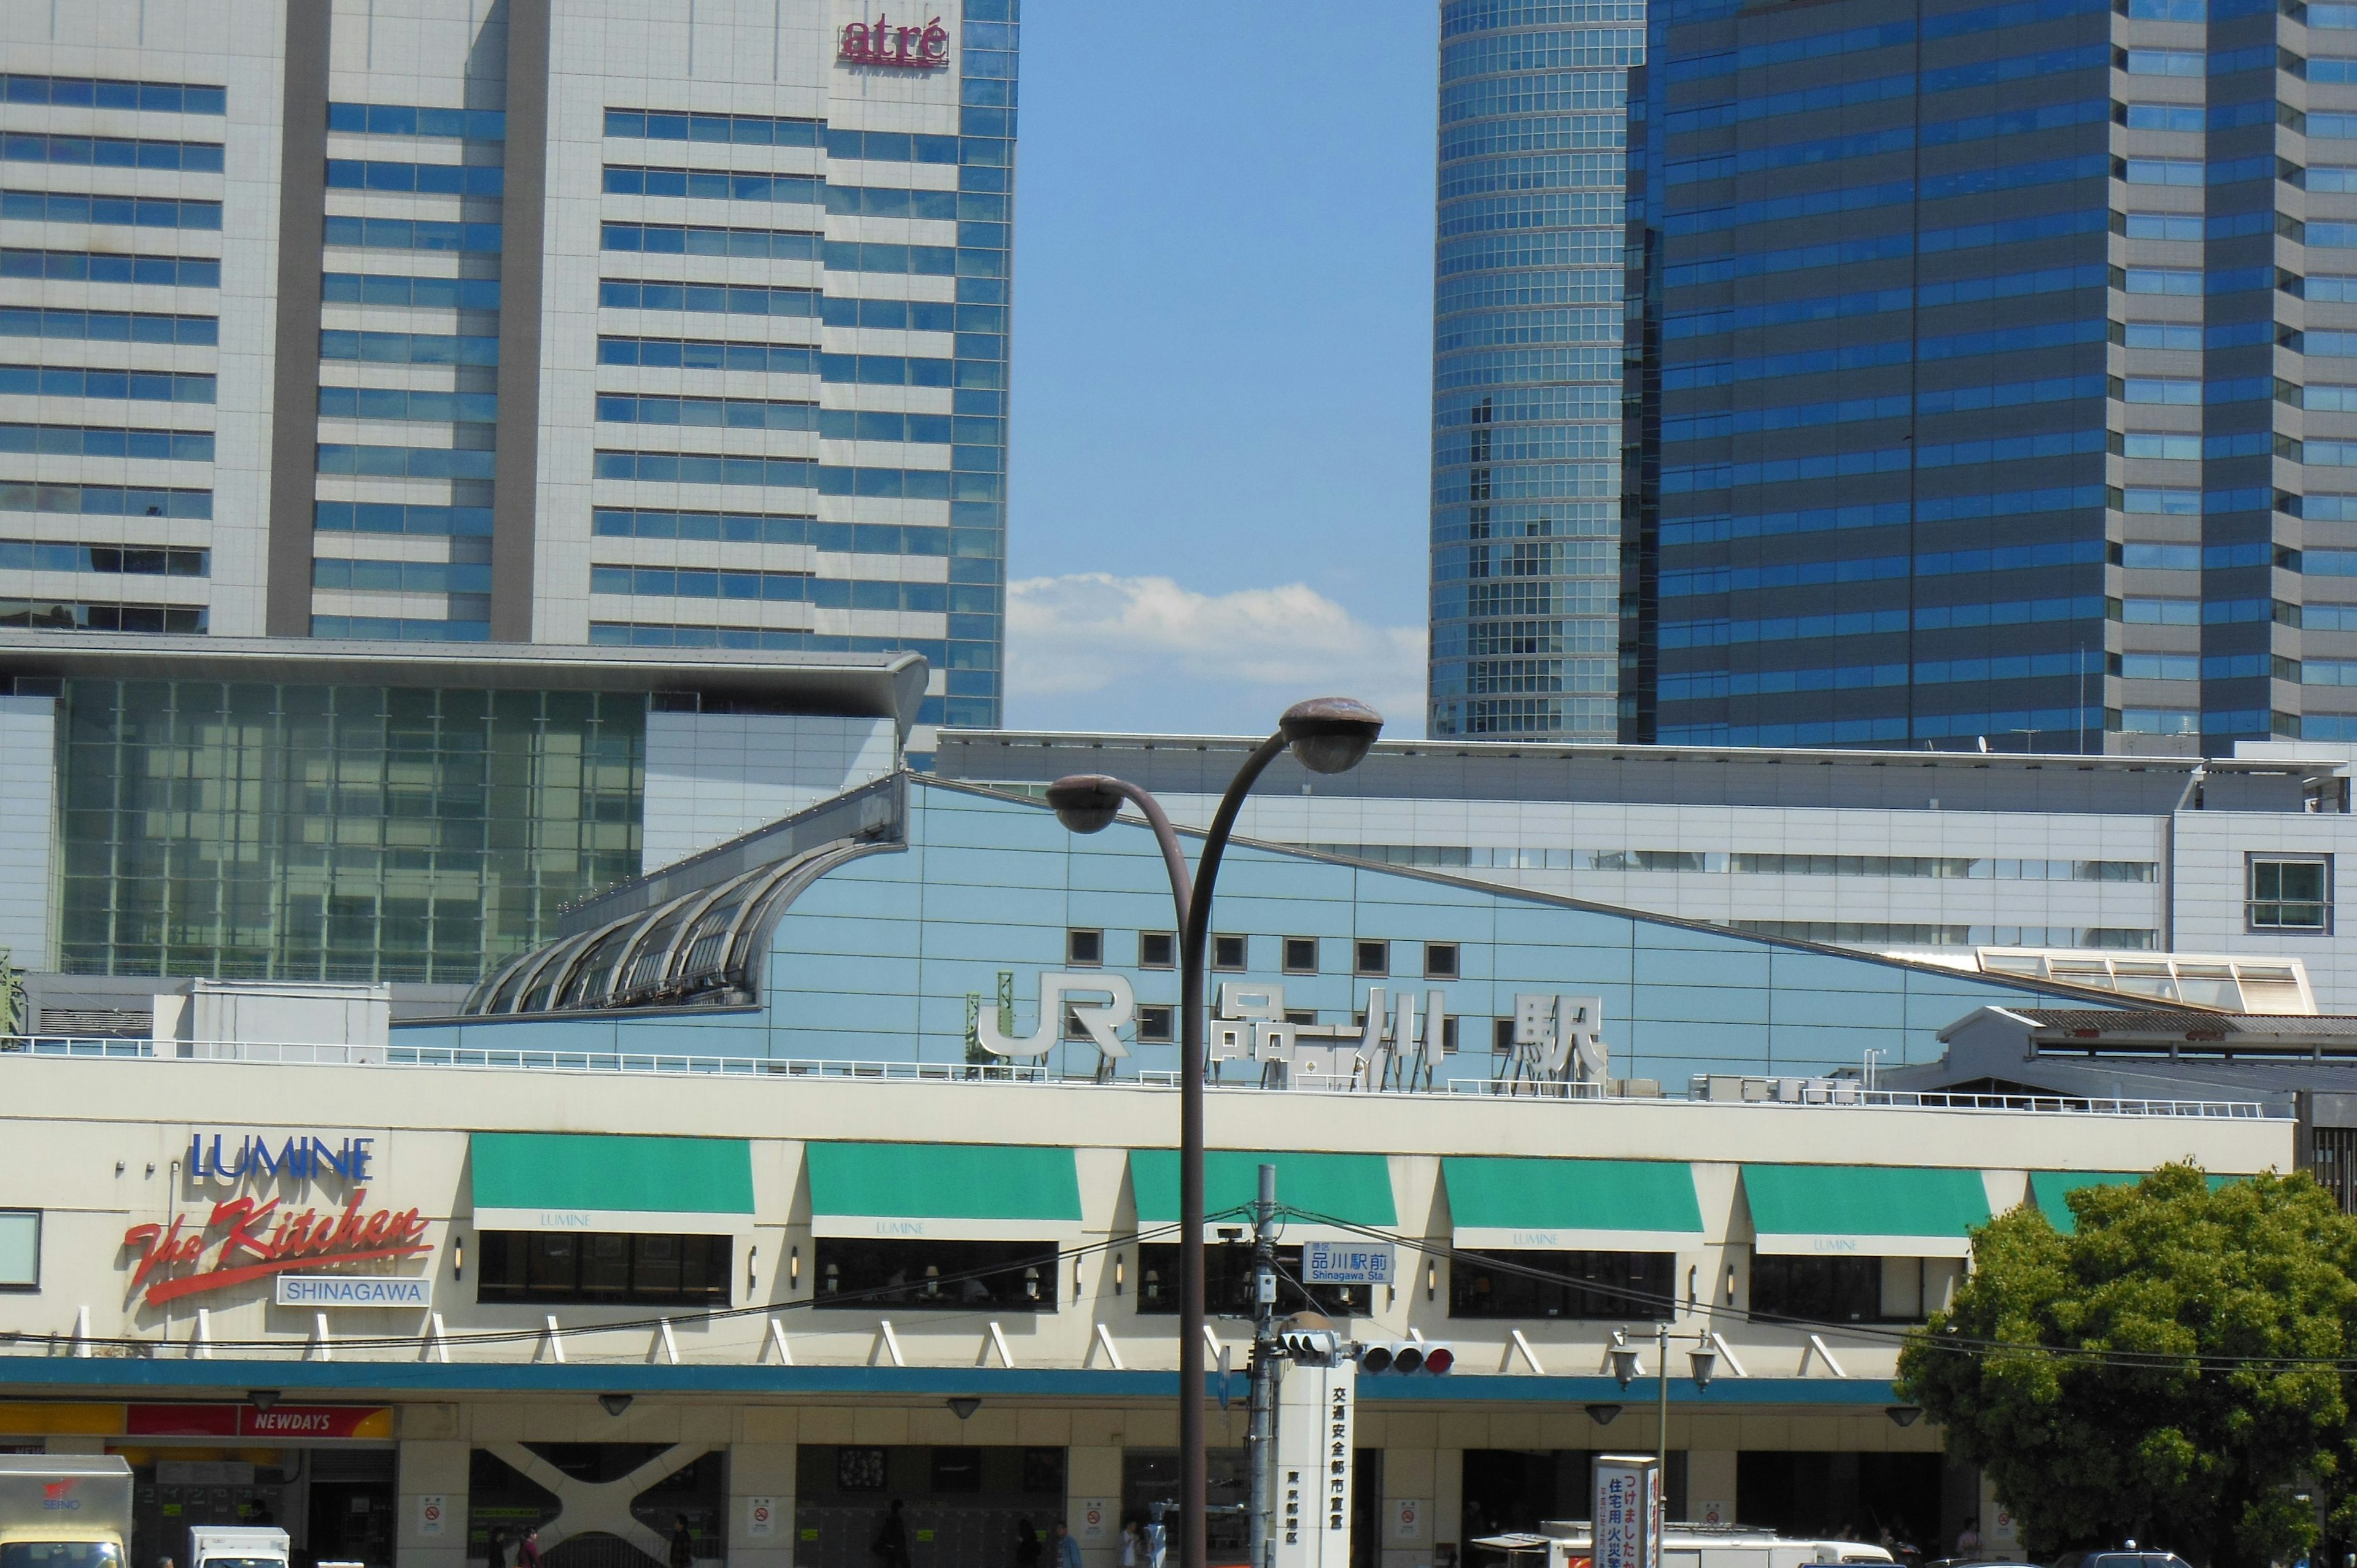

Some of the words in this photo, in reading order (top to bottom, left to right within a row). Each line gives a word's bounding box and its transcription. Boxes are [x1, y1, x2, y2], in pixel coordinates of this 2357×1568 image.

[843, 13, 946, 59] atré
[192, 1134, 374, 1180] LUMINE
[541, 1214, 592, 1226] LUMINE
[877, 1222, 924, 1234] LUMINE
[125, 1214, 204, 1286] The
[211, 1189, 430, 1261] Kitchen
[1514, 1233, 1558, 1245] LUMINE
[1814, 1239, 1857, 1250] LUMINE
[1312, 1253, 1387, 1270] 品川駅前
[1312, 1270, 1364, 1281] Shinagawa
[287, 1283, 422, 1301] SHINAGAWA
[255, 1414, 330, 1430] NEWDAYS
[1330, 1387, 1346, 1530] 交通安全都市宣言
